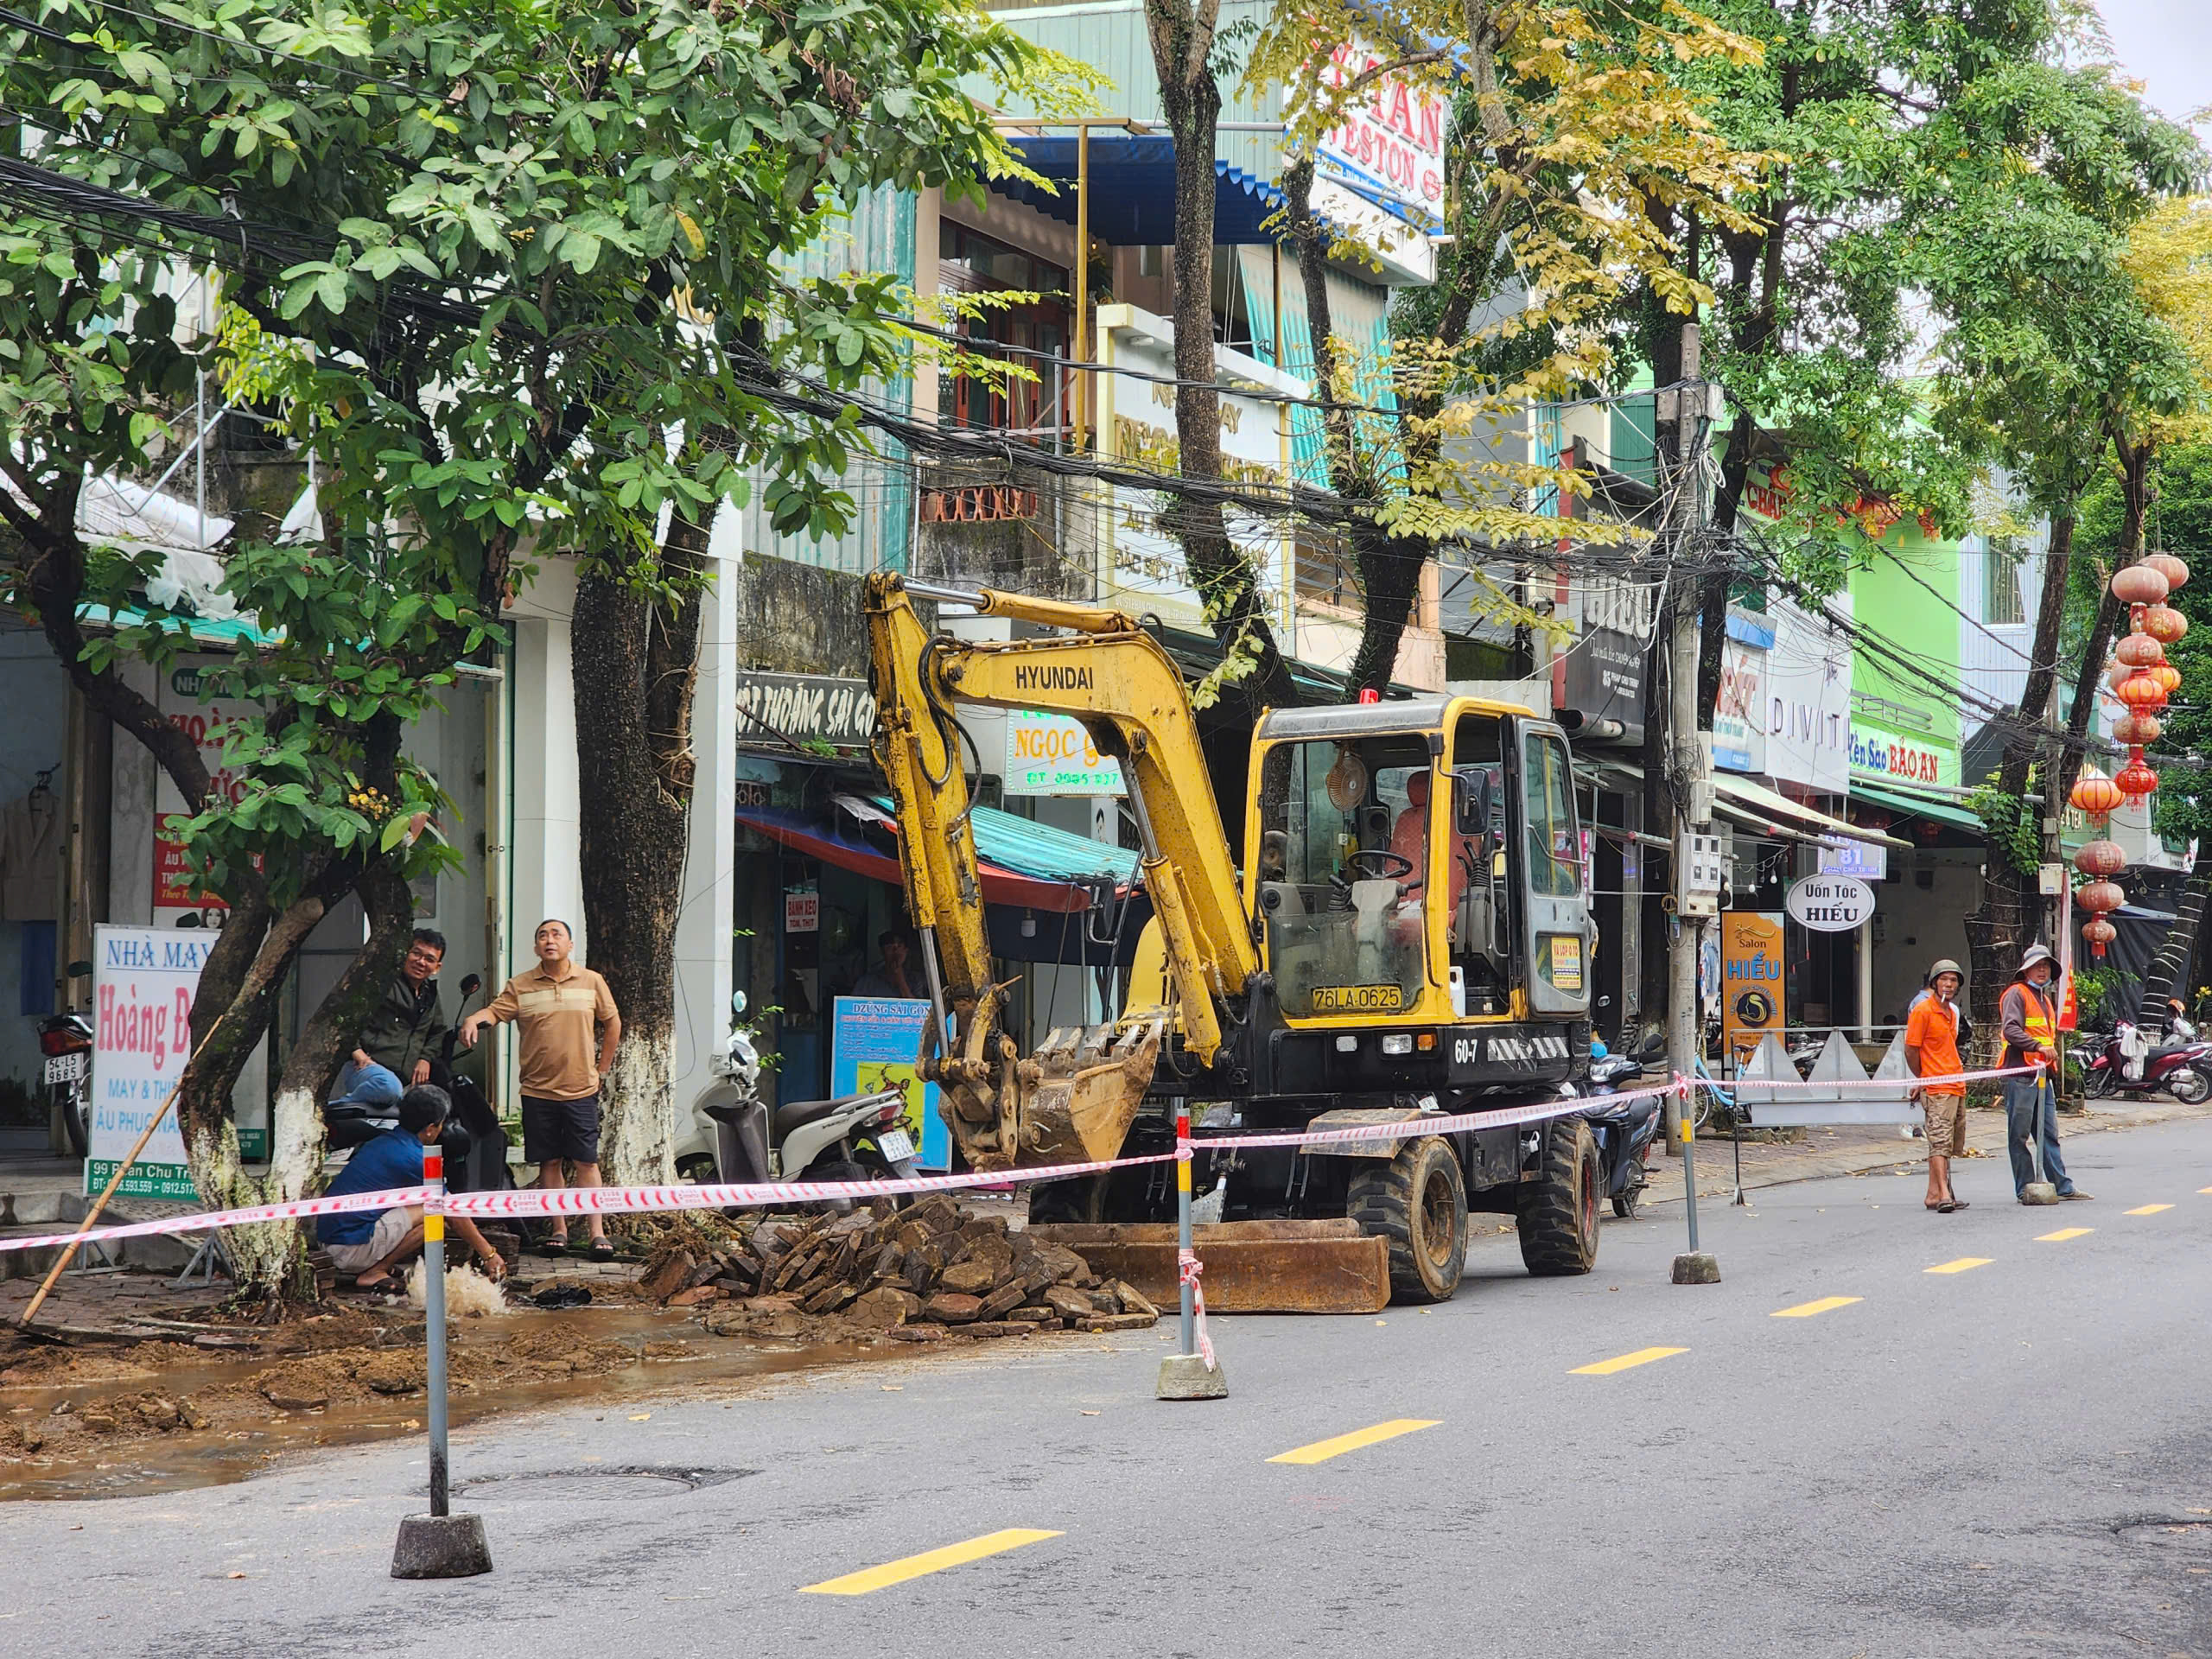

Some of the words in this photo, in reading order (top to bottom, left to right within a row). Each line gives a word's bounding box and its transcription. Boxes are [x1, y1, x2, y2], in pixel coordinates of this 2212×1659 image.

[1015, 665, 1094, 690] HYUNDAI
[825, 686, 854, 737] SÀI
[1014, 728, 1077, 766] NGỌC
[1889, 735, 1917, 777] BẢO
[1919, 752, 1938, 782] AN
[2071, 810, 2082, 830] TEA
[1840, 848, 1864, 865] 81
[1805, 882, 1830, 898] Uốn
[1834, 884, 1858, 899] Tóc
[1806, 901, 1859, 922] HIẾU
[106, 934, 156, 967] NHÀ
[1739, 938, 1767, 949] Salon
[1727, 950, 1781, 981] HIẾU
[98, 983, 168, 1071] Hoàng
[1454, 1039, 1478, 1064] 60-7
[48, 1054, 77, 1071] 54-L5
[48, 1067, 77, 1083] 9685
[107, 1078, 138, 1099] MAY
[141, 1080, 150, 1099] &
[96, 1106, 116, 1131] ÂU
[93, 1162, 108, 1175] 99
[111, 1163, 143, 1177] Pan
[146, 1166, 172, 1179] Chu
[175, 1166, 192, 1179] Tr
[92, 1178, 106, 1189] ĐT:
